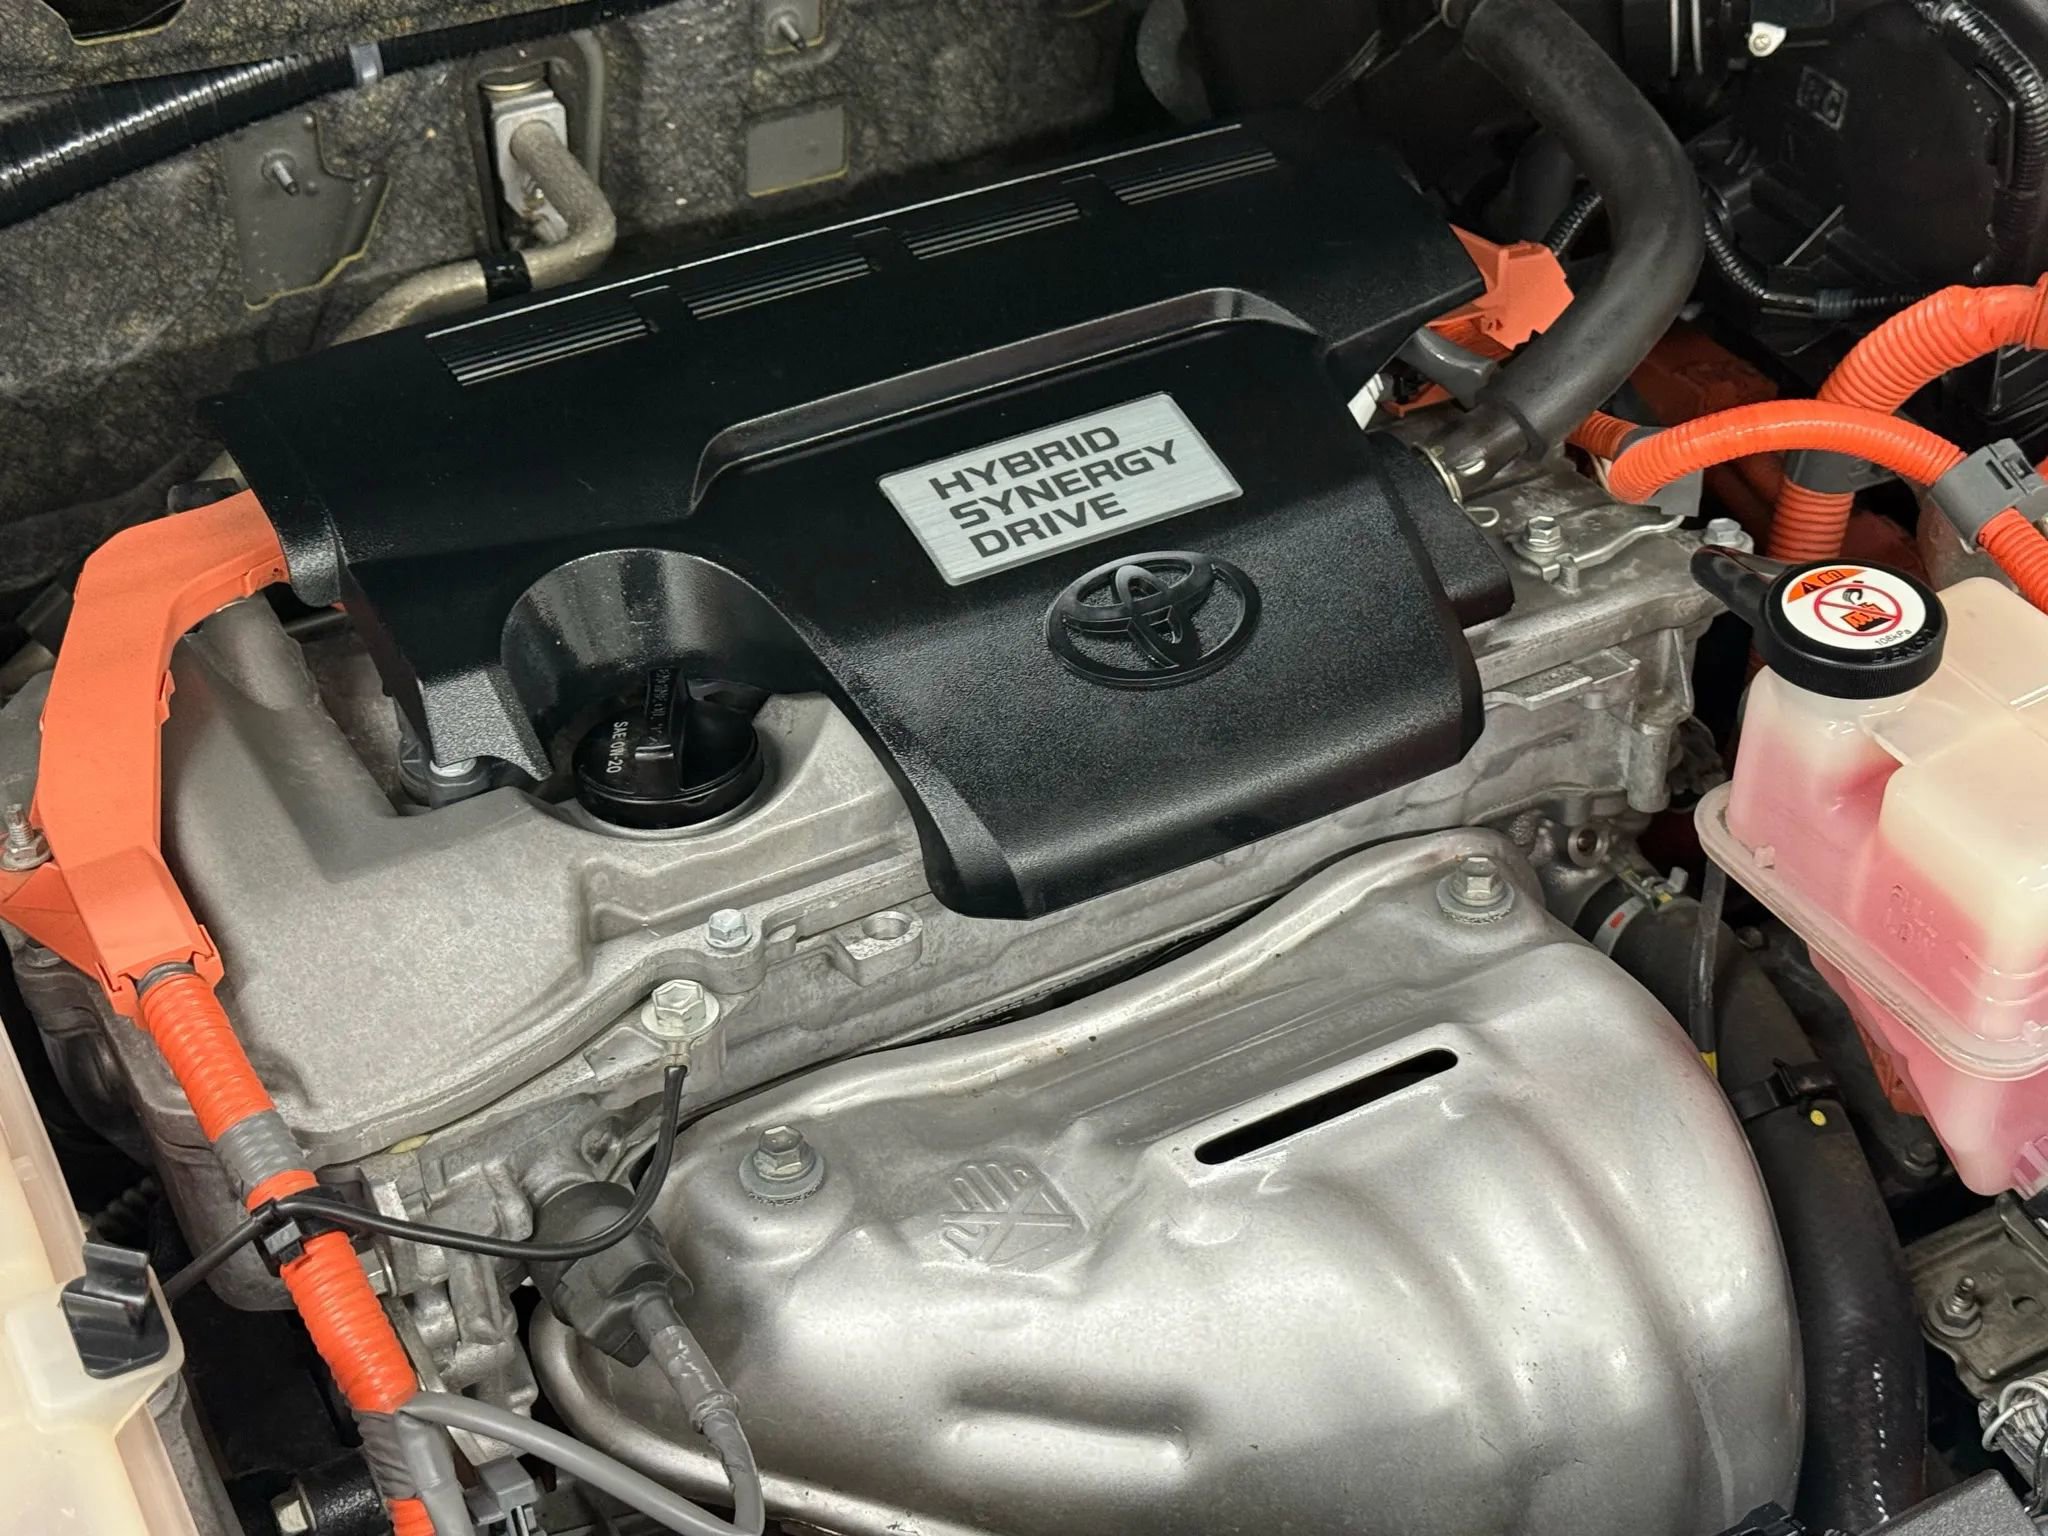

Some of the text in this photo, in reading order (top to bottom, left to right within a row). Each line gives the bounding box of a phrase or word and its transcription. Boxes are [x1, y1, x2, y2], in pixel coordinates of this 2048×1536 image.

[928, 426, 1120, 500] HYBRID
[949, 439, 1178, 530] SYNERGY
[968, 492, 1128, 558] DRIVE
[1875, 629, 1912, 645] 108kPa
[606, 721, 629, 773] SAE 0W-20
